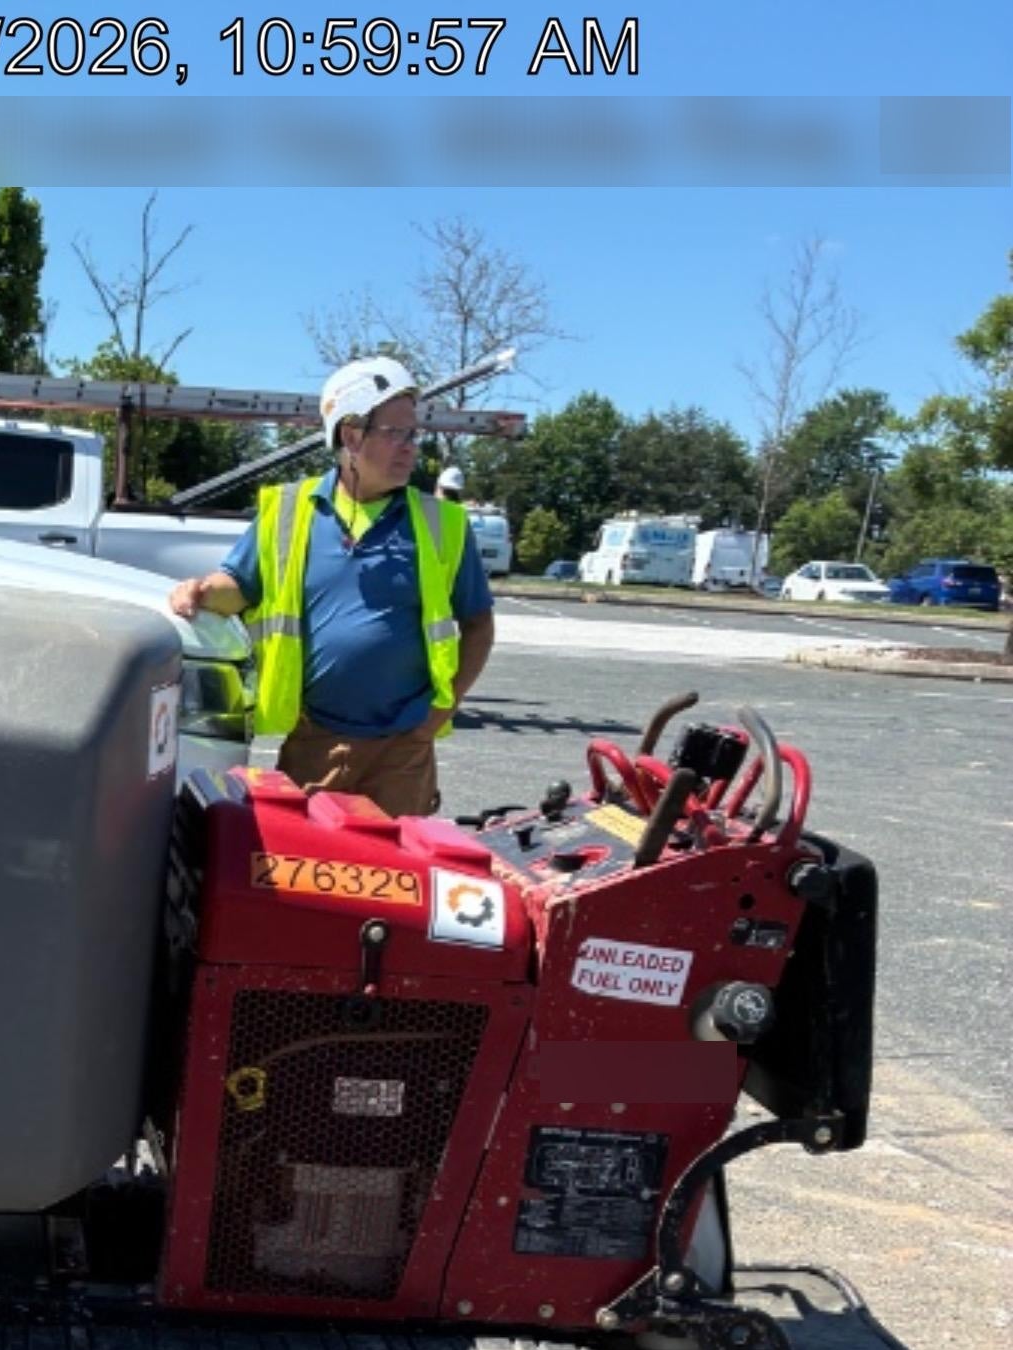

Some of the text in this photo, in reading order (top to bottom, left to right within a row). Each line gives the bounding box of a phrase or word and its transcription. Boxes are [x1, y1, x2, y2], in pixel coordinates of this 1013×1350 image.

[254, 854, 422, 904] 276329
[580, 944, 685, 974] UNLEADED
[577, 968, 679, 998] FUEL ONLY
